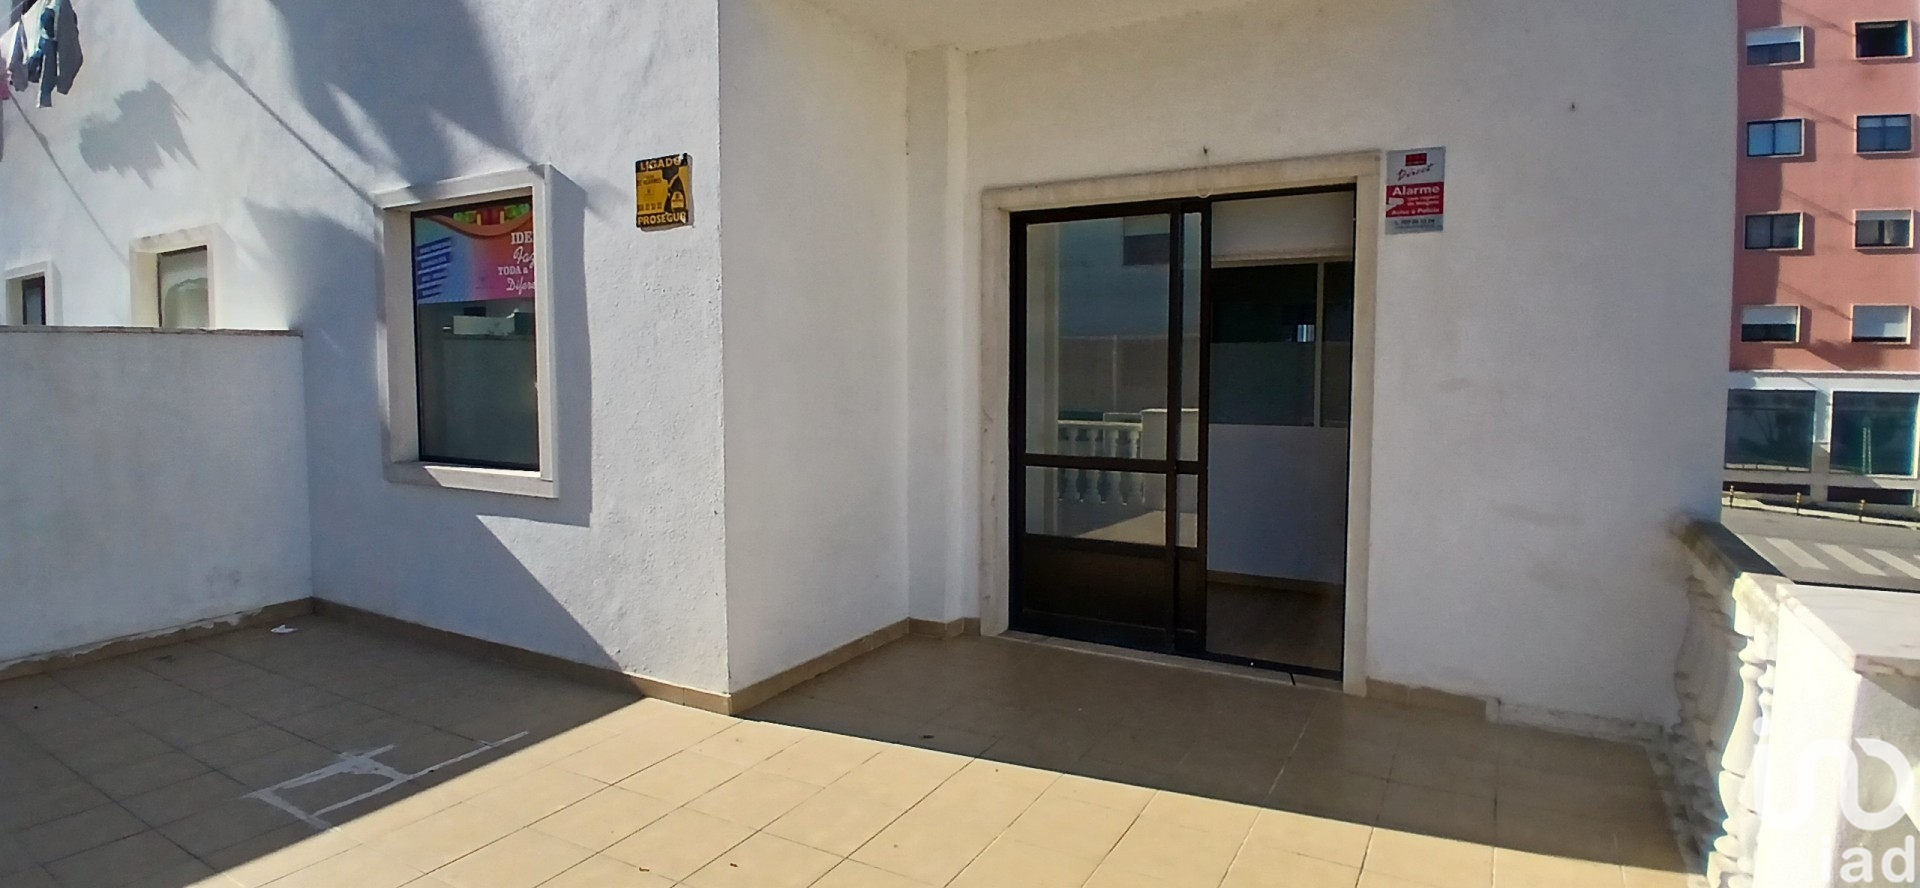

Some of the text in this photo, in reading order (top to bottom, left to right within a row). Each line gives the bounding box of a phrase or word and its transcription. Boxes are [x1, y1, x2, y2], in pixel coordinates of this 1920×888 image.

[640, 156, 682, 171] LIGADO
[1392, 185, 1440, 196] Alarme
[638, 211, 687, 225] PROSEGUR
[498, 265, 522, 276] TODA
